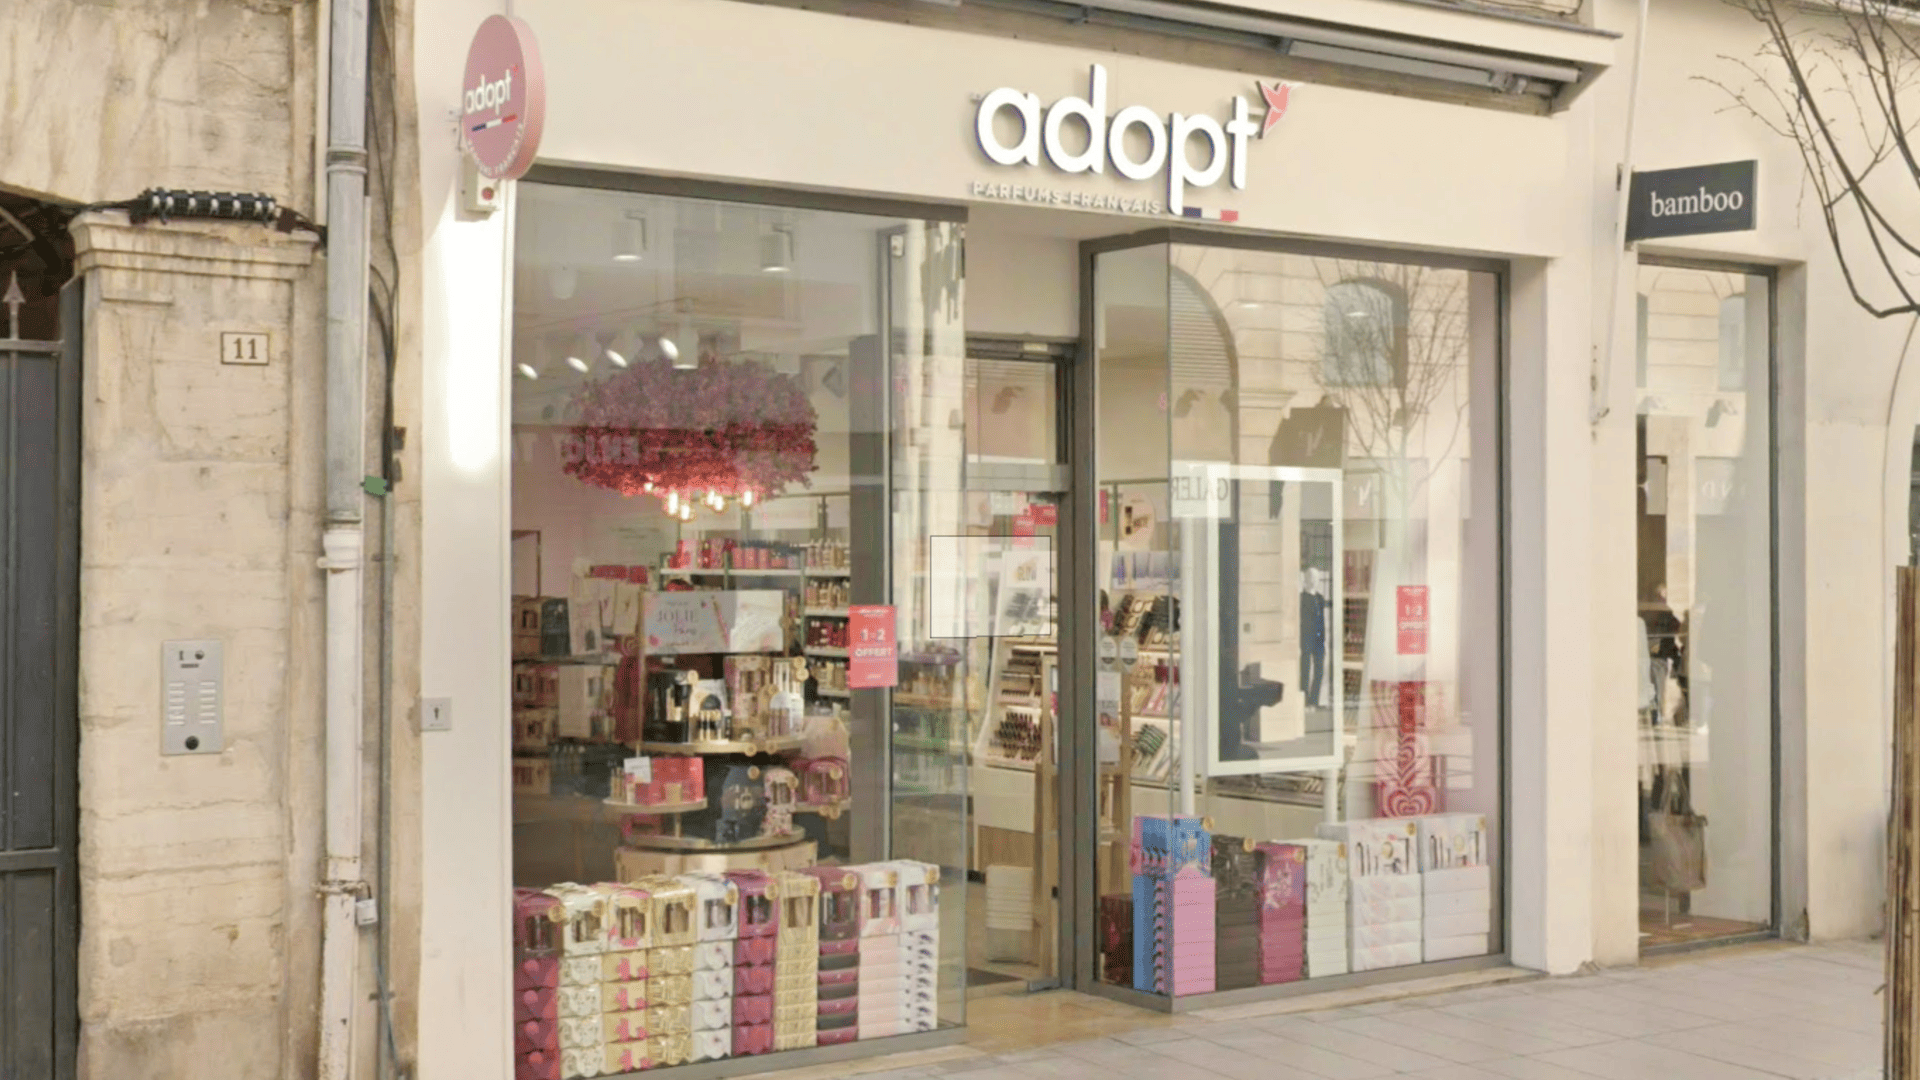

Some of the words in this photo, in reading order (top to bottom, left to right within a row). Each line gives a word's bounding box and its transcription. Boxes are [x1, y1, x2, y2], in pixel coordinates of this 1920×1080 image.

[465, 68, 511, 116] adopt
[976, 63, 1259, 216] adopt
[972, 180, 1062, 204] PARFUMS
[1069, 190, 1162, 214] FRANÇAIS
[1650, 186, 1744, 218] bamboo
[233, 337, 258, 360] 11
[854, 647, 892, 658] OFFERT
